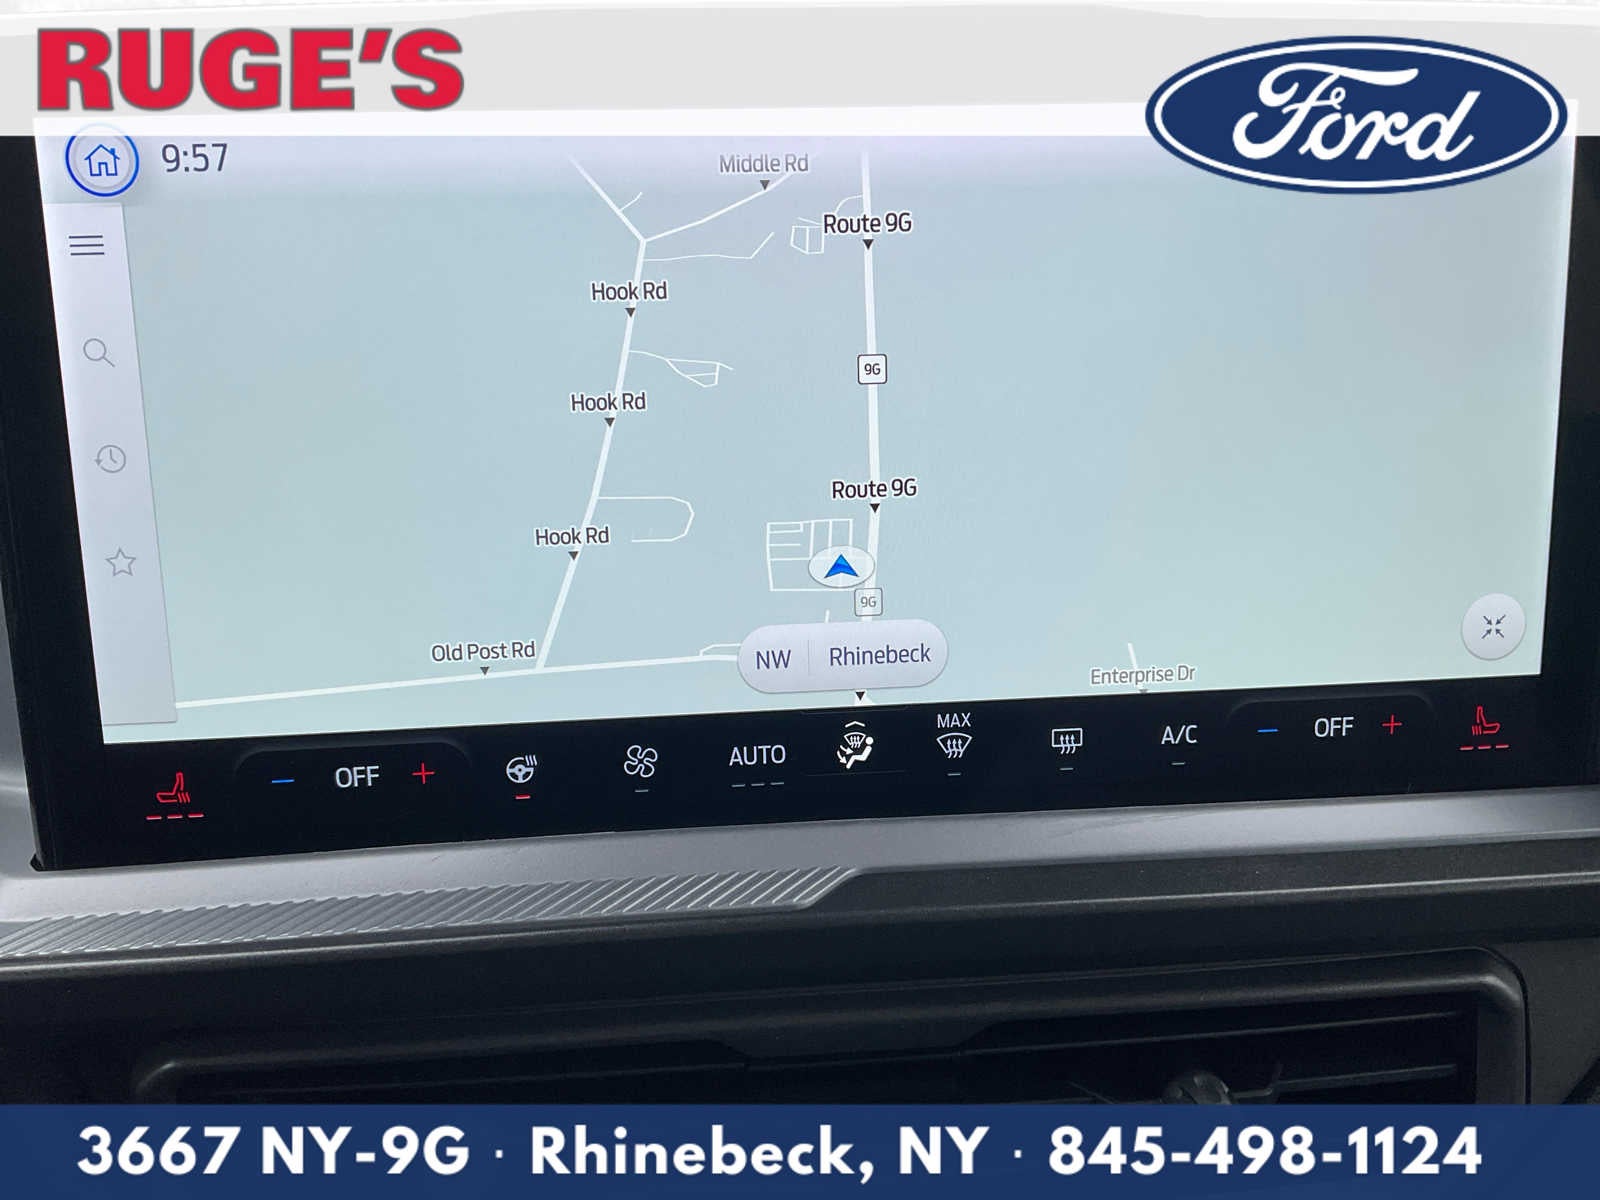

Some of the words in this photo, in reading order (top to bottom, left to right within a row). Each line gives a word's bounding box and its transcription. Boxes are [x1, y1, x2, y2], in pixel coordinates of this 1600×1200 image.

[161, 143, 229, 174] 9:57
[719, 153, 781, 174] Middle
[784, 152, 809, 173] Rd
[823, 212, 881, 234] Route
[884, 212, 912, 233] 9G
[591, 280, 638, 301] Hook
[643, 280, 668, 301] Rd
[863, 362, 881, 377] 9G
[570, 392, 617, 412] Hook
[622, 391, 646, 411] Rd
[832, 479, 888, 500] Route
[891, 477, 917, 498] 9G
[535, 527, 581, 547] Hook
[586, 525, 610, 545] Rd
[860, 595, 877, 609] 9G
[431, 642, 462, 662] Old
[468, 640, 508, 661] Post
[511, 640, 536, 659] Rd
[756, 649, 792, 669] NW
[829, 641, 932, 668] Rhinebeck
[1090, 664, 1174, 686] Enterprise
[1177, 664, 1196, 682] Dr
[936, 712, 972, 729] MAX
[1314, 716, 1355, 739] OFF
[1161, 724, 1198, 746] A/C
[729, 743, 787, 768] AUTO
[334, 764, 380, 789] OFF
